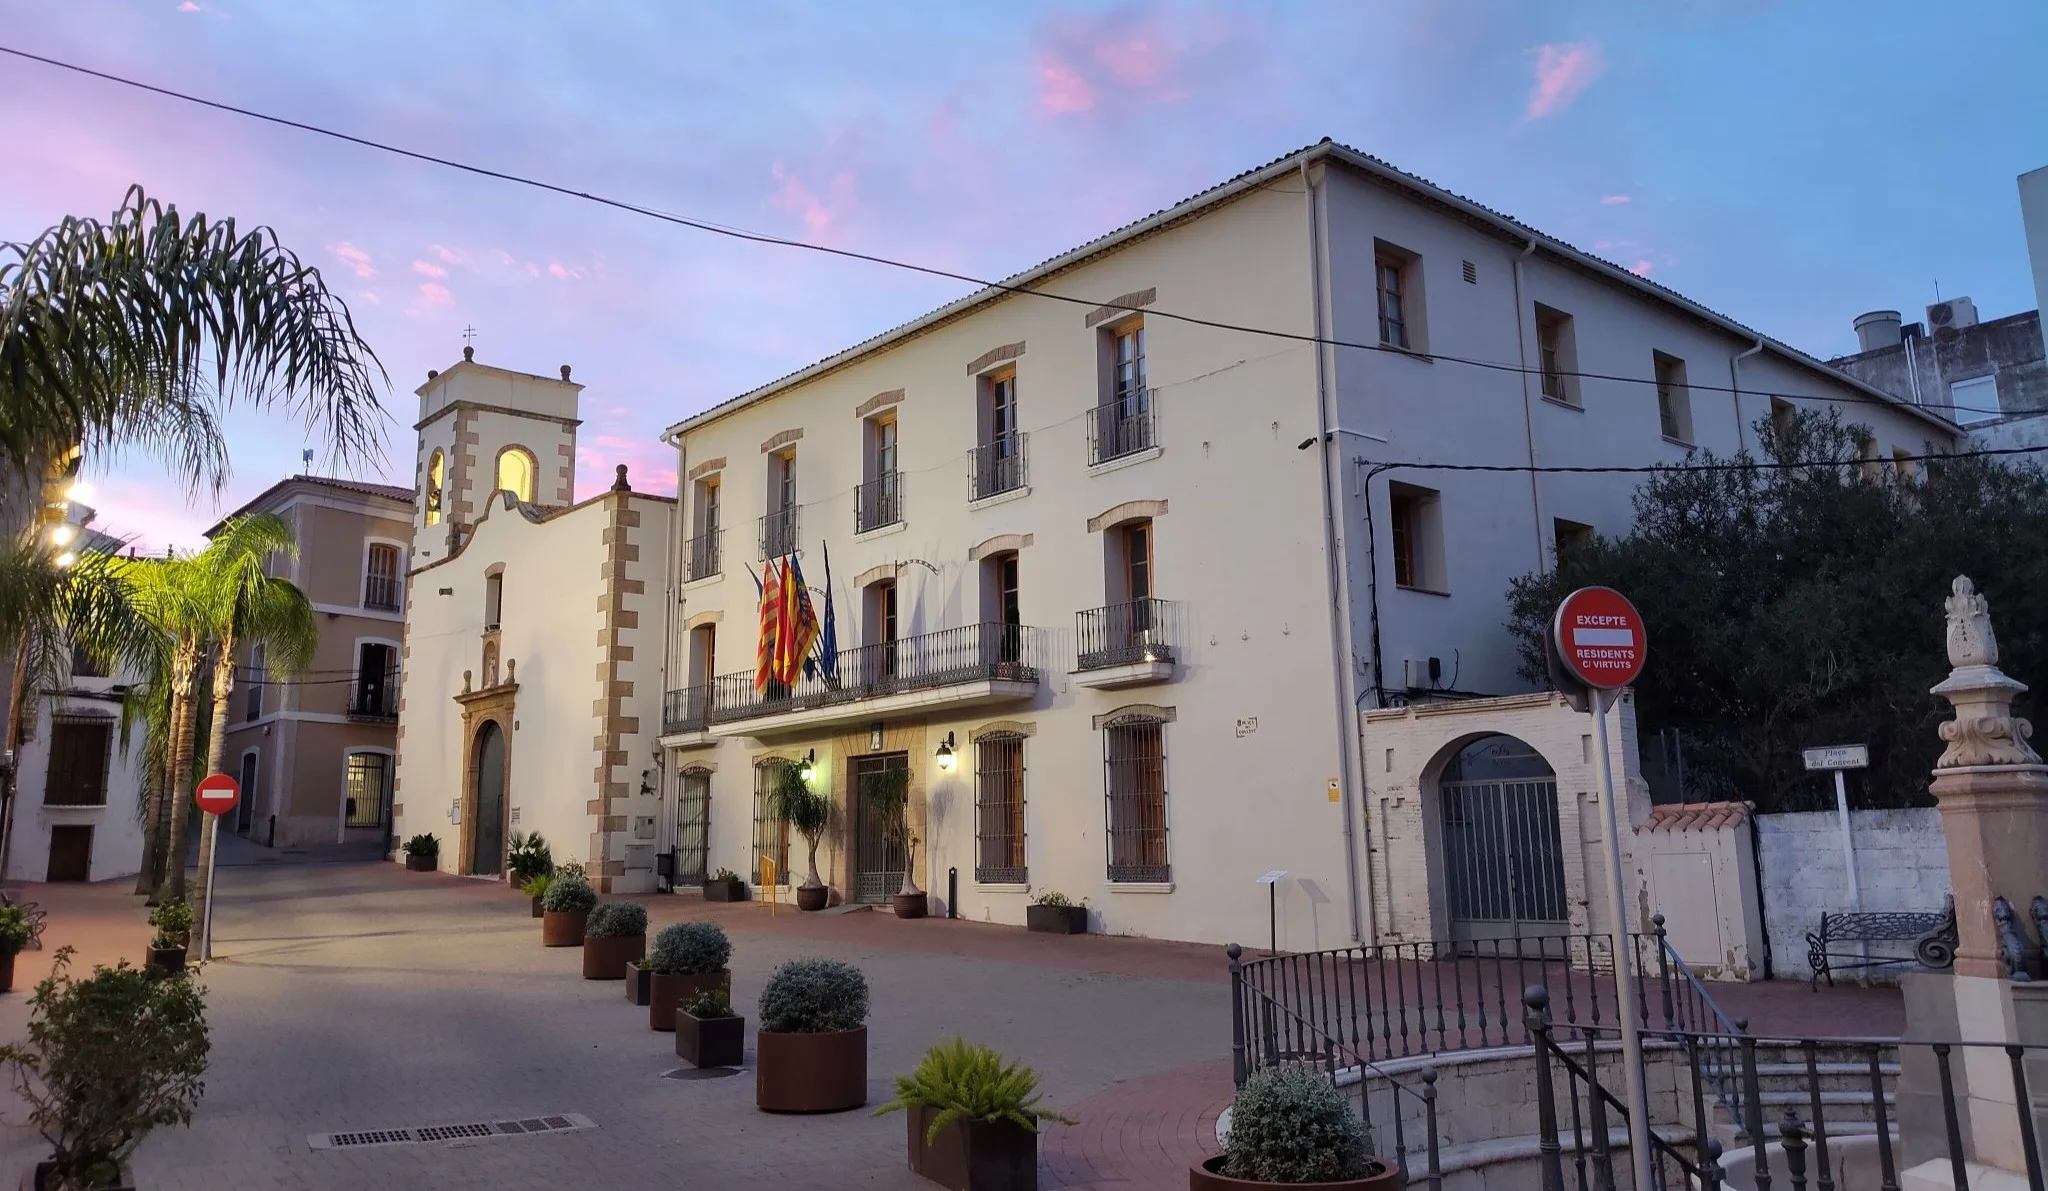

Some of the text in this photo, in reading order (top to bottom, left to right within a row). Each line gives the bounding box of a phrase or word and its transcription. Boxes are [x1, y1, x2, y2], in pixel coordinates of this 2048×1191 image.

[1576, 615, 1627, 626] EXCEPTE
[1576, 649, 1635, 659] RESIDENTS
[1593, 660, 1632, 669] VIRTUTS
[1825, 749, 1847, 757] Plaça
[1827, 758, 1860, 766] Convent
